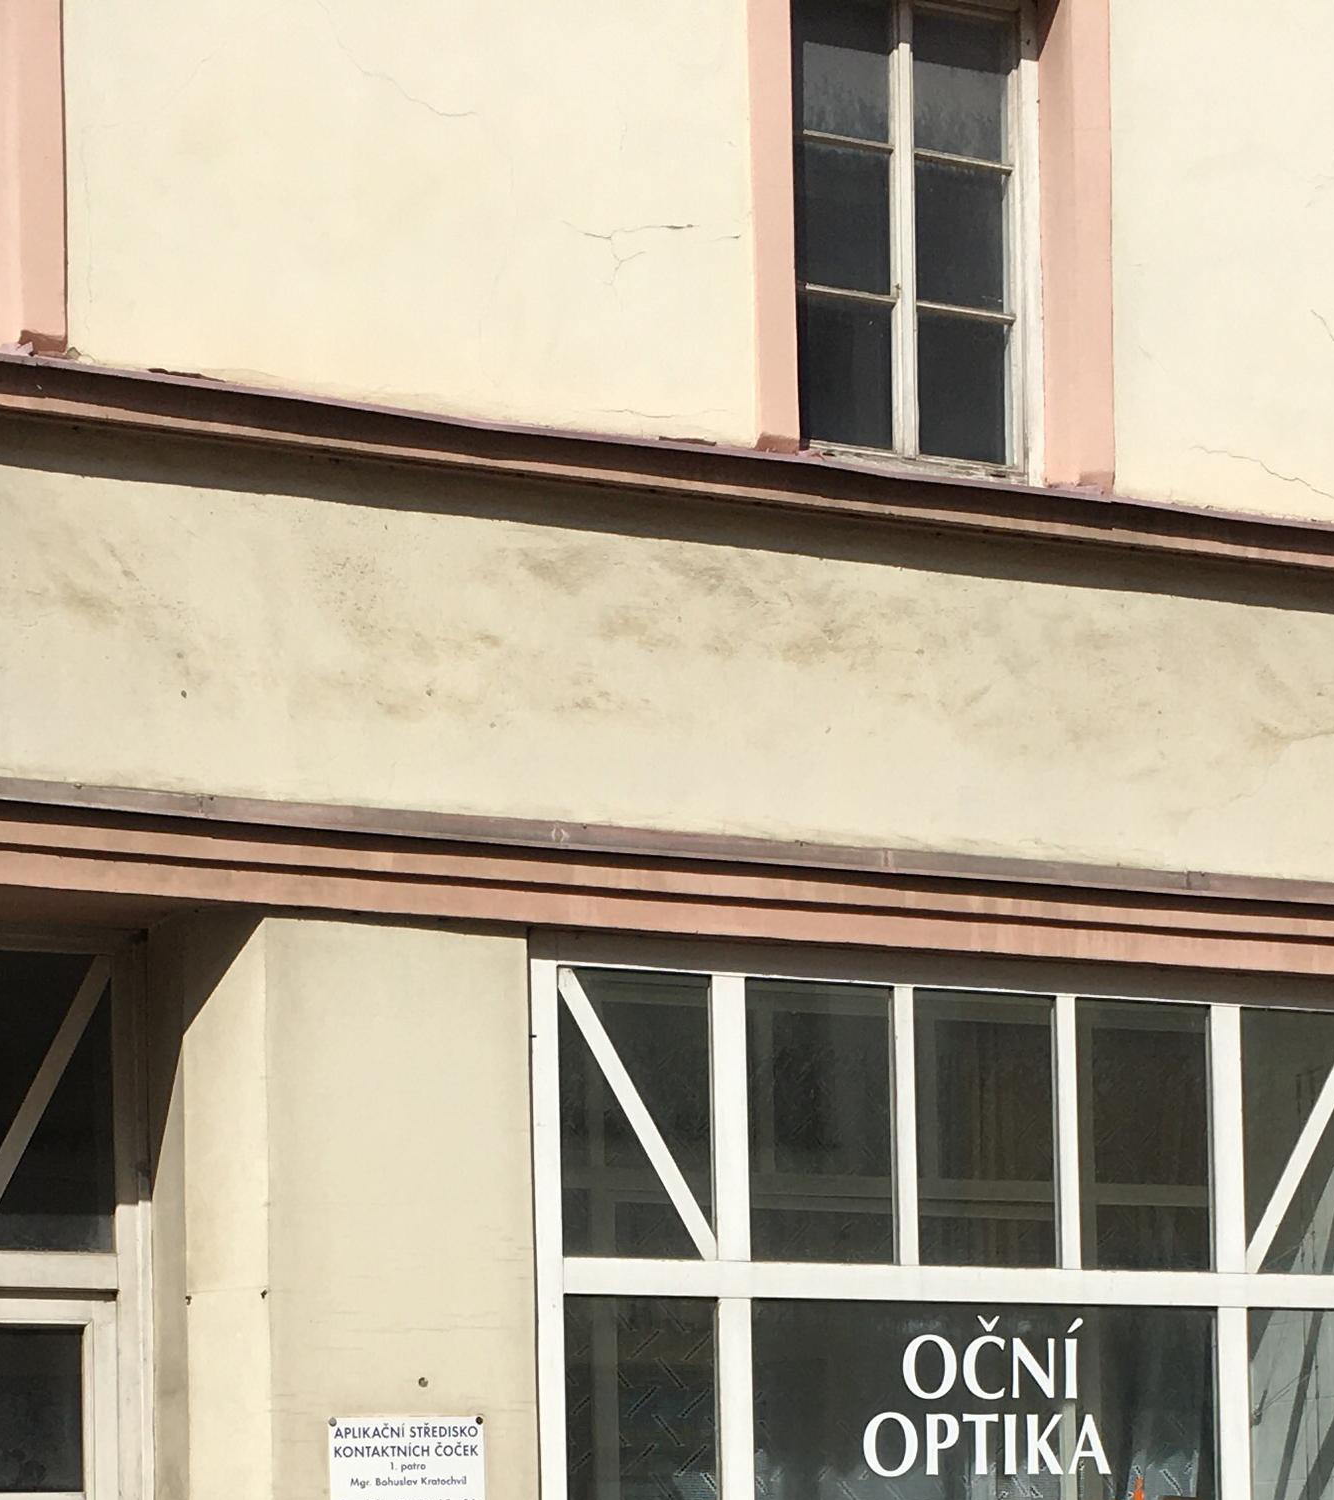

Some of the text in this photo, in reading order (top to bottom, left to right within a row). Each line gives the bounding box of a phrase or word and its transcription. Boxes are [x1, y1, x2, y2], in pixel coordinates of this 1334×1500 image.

[902, 1315, 1084, 1399] OČNÍ
[333, 1423, 479, 1439] APLIKAČNÍ STŘEDISKO
[333, 1441, 479, 1458] KONTAKTNÍCH ČOČEK
[862, 1410, 1112, 1477] OPTIKA
[401, 1462, 427, 1472] patro
[349, 1476, 467, 1490] Mgr. Bohuslav Kratochvíl
